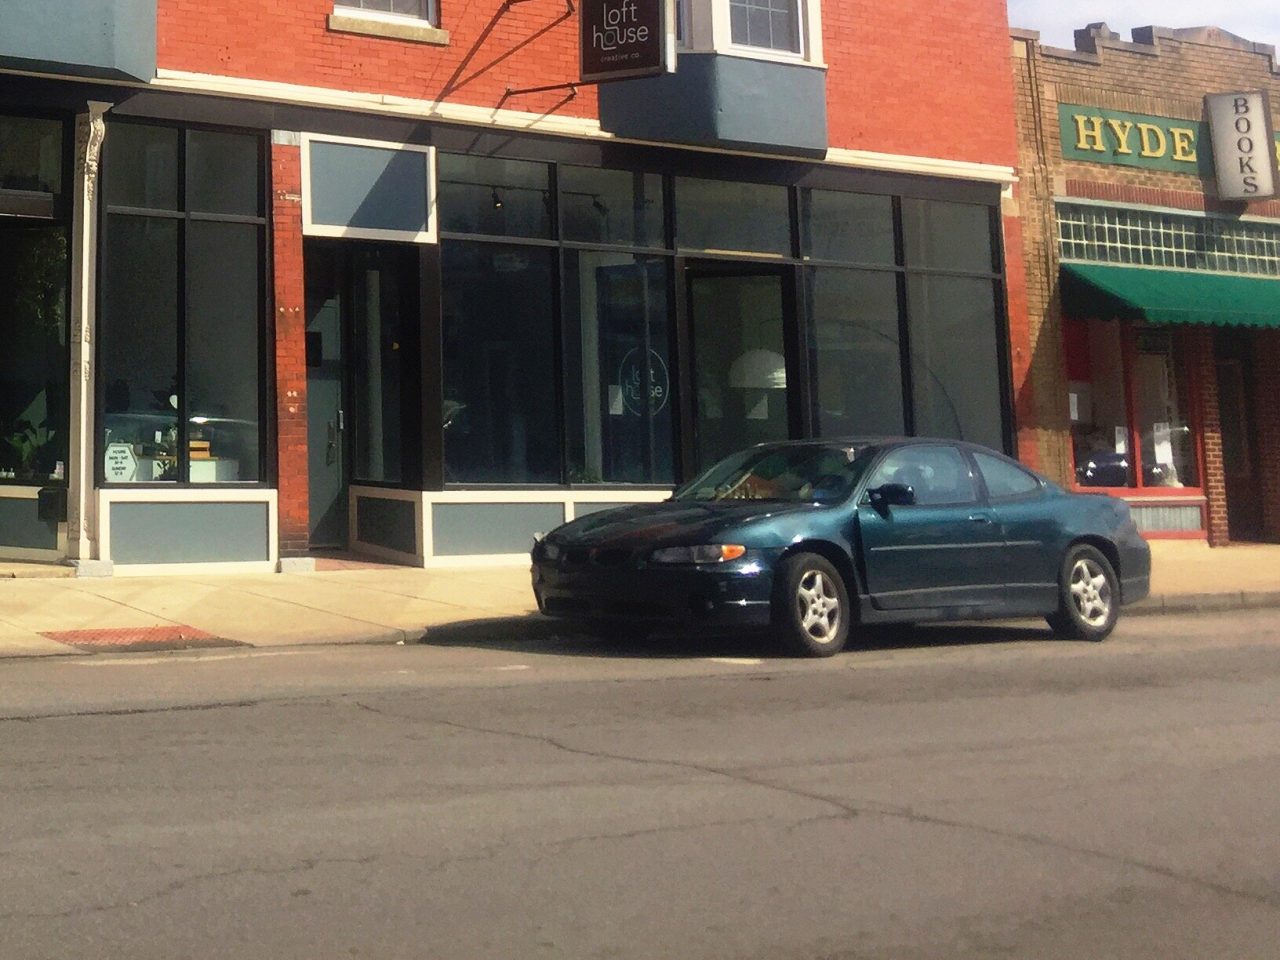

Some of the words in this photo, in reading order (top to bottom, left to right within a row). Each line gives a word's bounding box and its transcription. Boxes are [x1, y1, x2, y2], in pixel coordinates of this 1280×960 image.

[603, 0, 638, 29] loft
[593, 25, 649, 51] house
[1073, 114, 1197, 163] HYDE
[1233, 97, 1260, 194] BOOKS
